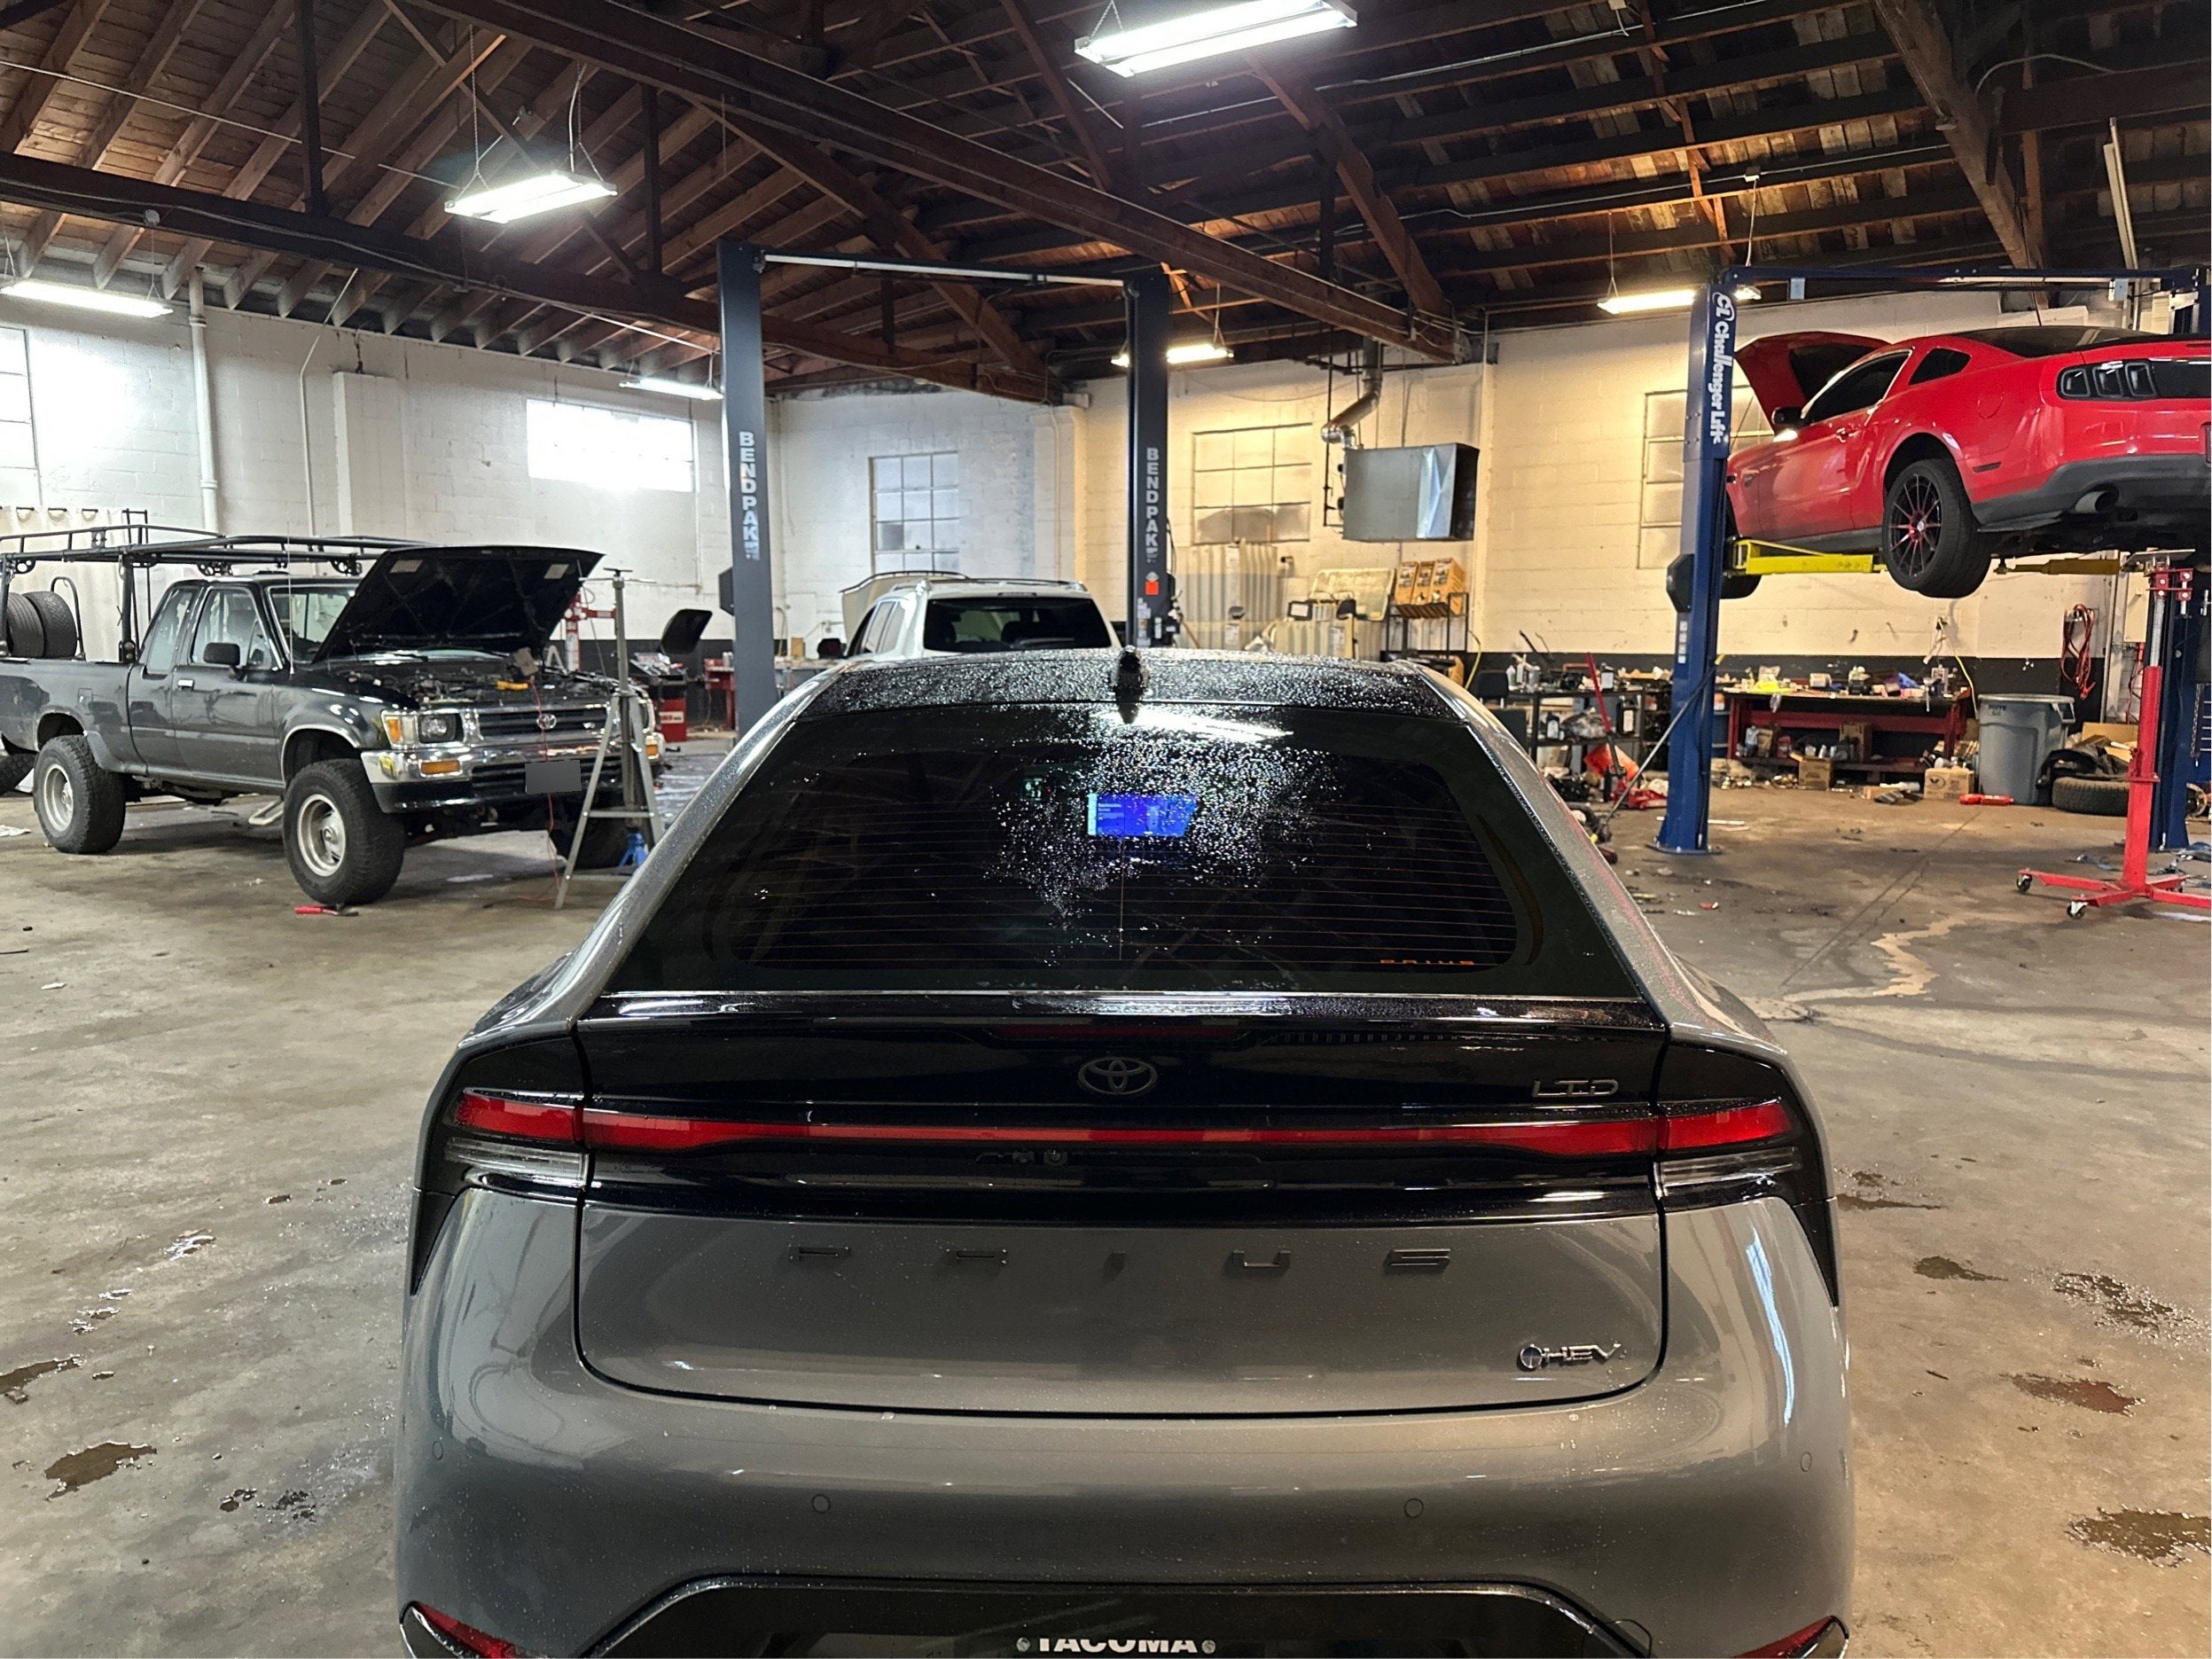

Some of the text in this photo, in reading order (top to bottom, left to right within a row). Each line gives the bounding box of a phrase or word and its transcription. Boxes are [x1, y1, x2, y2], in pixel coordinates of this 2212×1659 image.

[1708, 321, 1733, 411] Challenger
[739, 431, 759, 541] BENDPAK
[1145, 447, 1160, 547] BENDPAK
[1531, 1078, 1619, 1098] LTD
[1543, 1342, 1622, 1363] HEV
[1039, 1638, 1198, 1653] TACOMA
